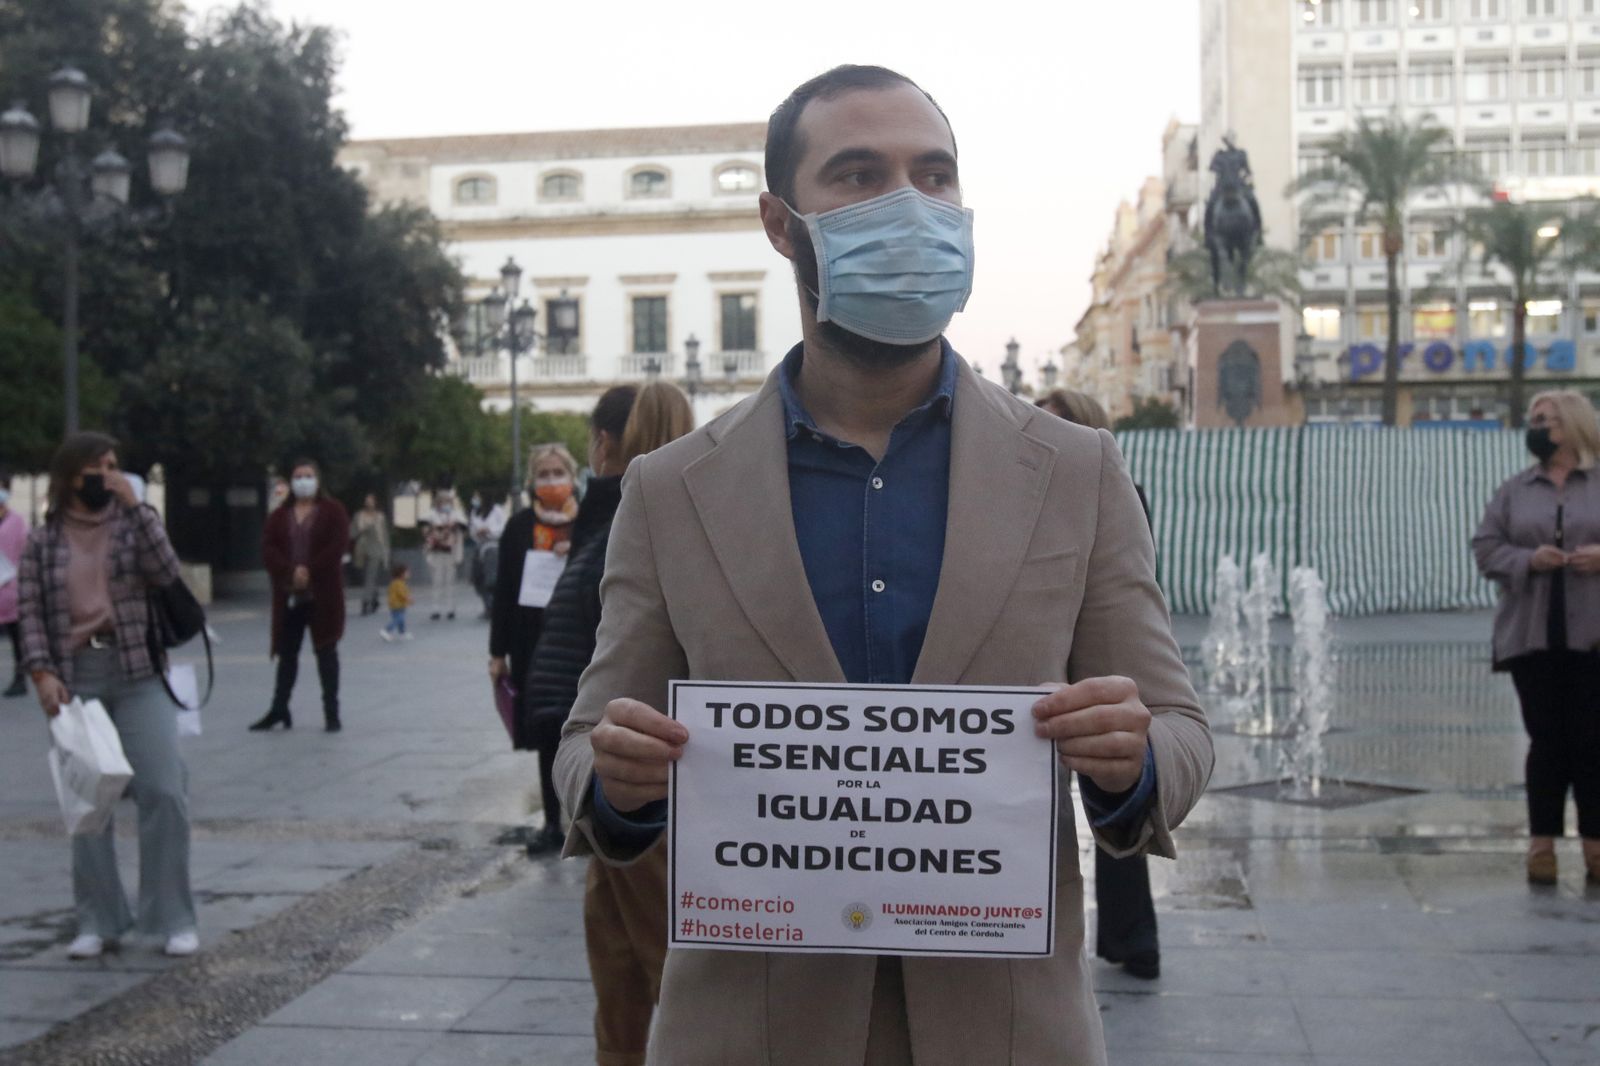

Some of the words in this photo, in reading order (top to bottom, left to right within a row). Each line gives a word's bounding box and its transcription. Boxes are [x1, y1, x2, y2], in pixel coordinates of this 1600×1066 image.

[705, 702, 850, 732] TODOS
[864, 705, 1015, 735] SOMOS
[733, 743, 987, 774] ESENCIALES
[837, 780, 862, 789] POR
[866, 780, 881, 789] LA
[757, 793, 972, 825] IGUALDAD
[850, 830, 865, 838] DE
[715, 841, 1002, 875] CONDICIONES
[681, 891, 795, 913] #comercio
[882, 903, 980, 916] ILUMINANDO
[984, 907, 1043, 919] JUNT@S
[681, 919, 804, 941] #hosteleria
[940, 920, 968, 928] Amigos
[971, 921, 1025, 929] Comerciantes
